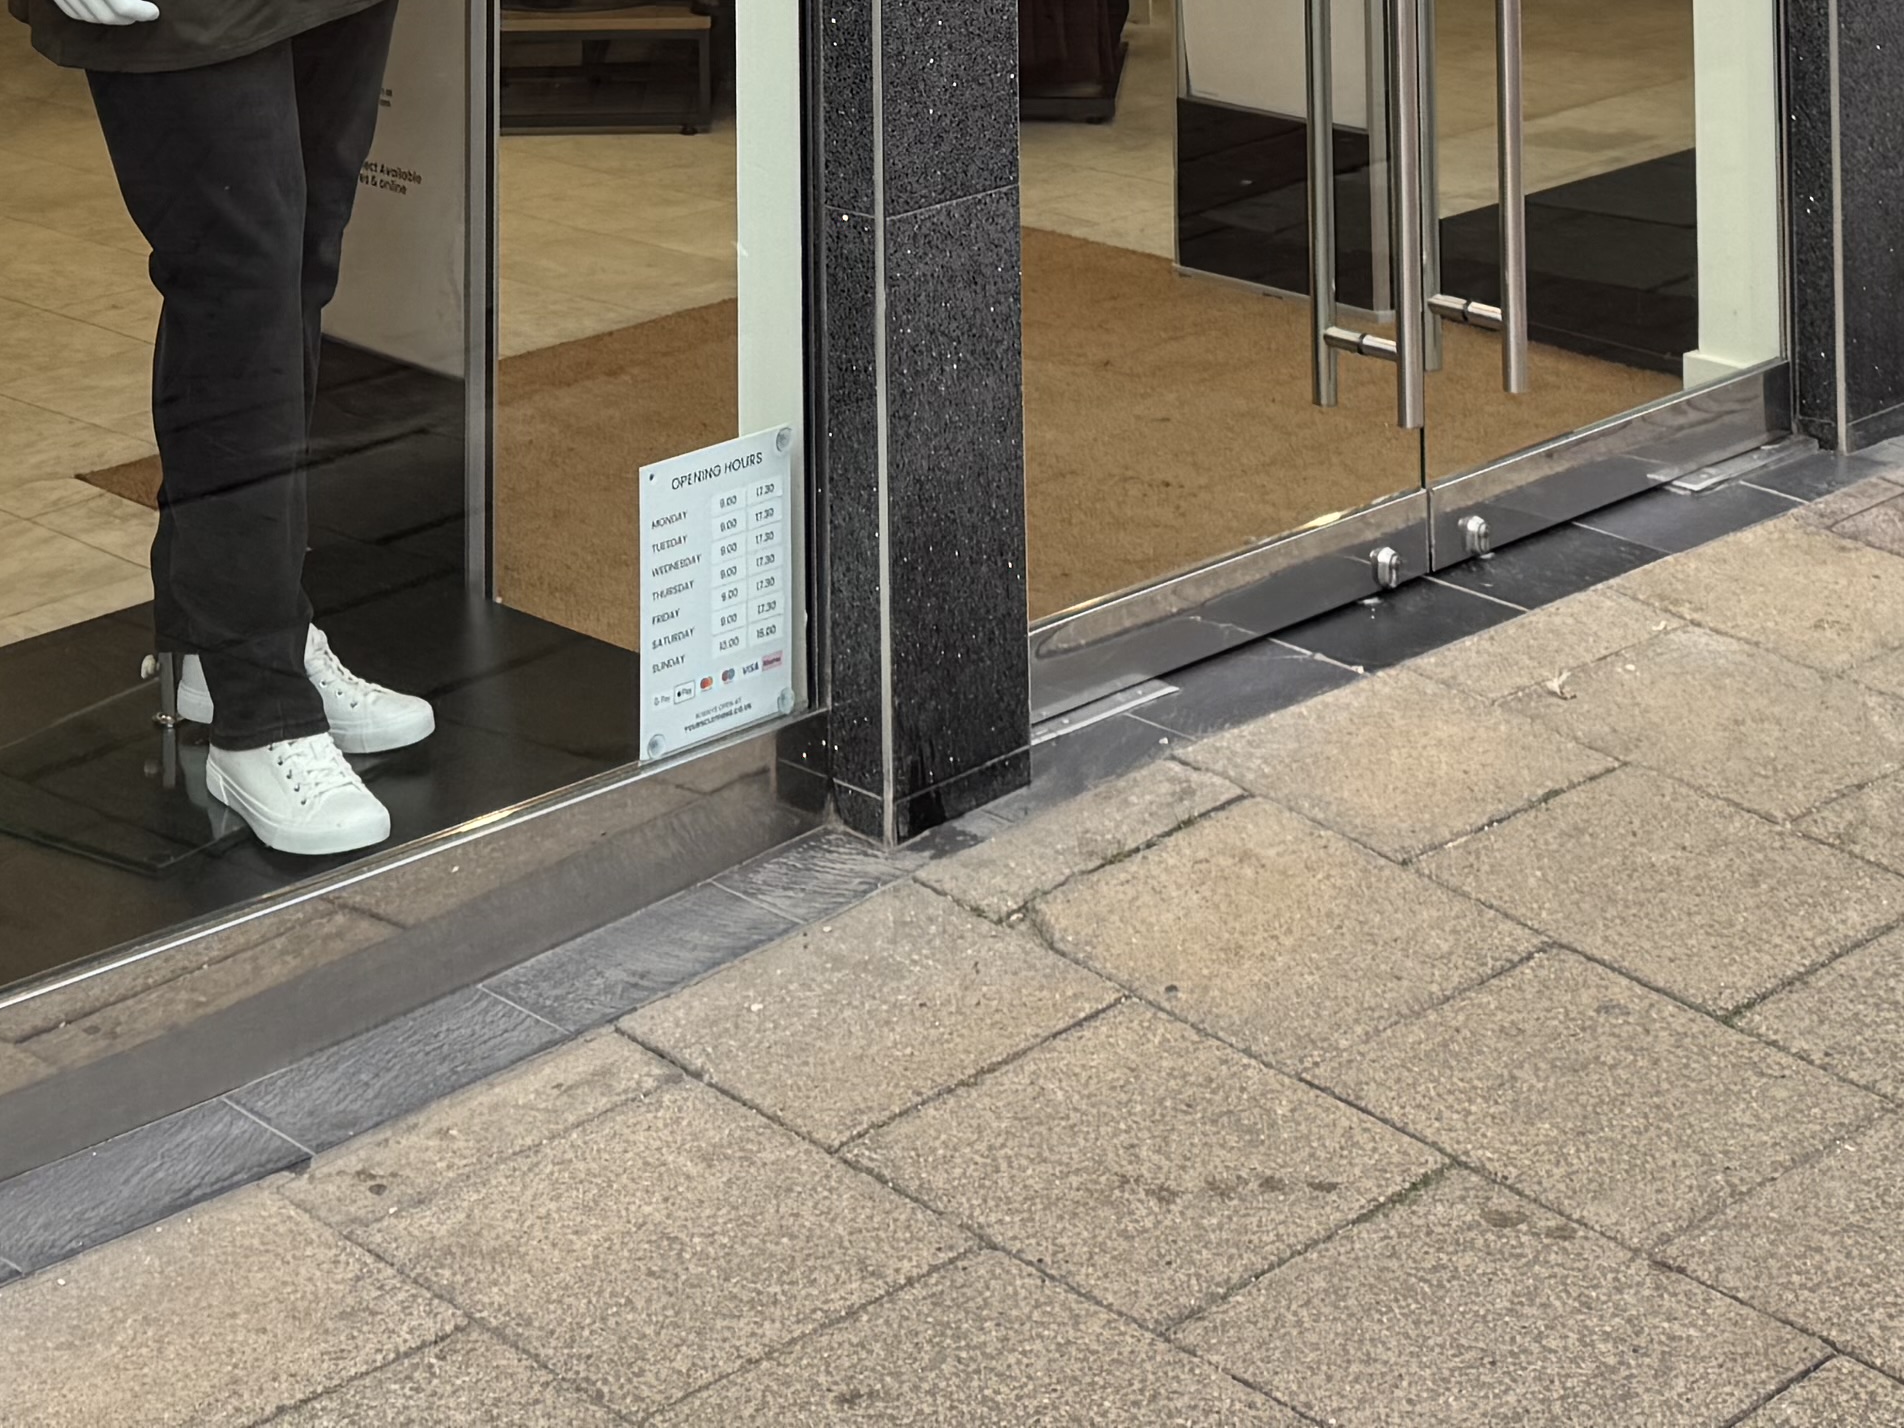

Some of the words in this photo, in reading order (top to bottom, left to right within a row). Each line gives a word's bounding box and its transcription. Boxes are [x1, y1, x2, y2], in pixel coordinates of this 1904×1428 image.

[671, 464, 722, 491] OPENING
[724, 451, 763, 474] HOURS
[651, 510, 688, 530] MONDAY
[652, 607, 681, 626] FRIDAY
[652, 626, 695, 650] SATURDAY
[652, 654, 686, 674] SUNDAY
[742, 661, 760, 675] VISA
